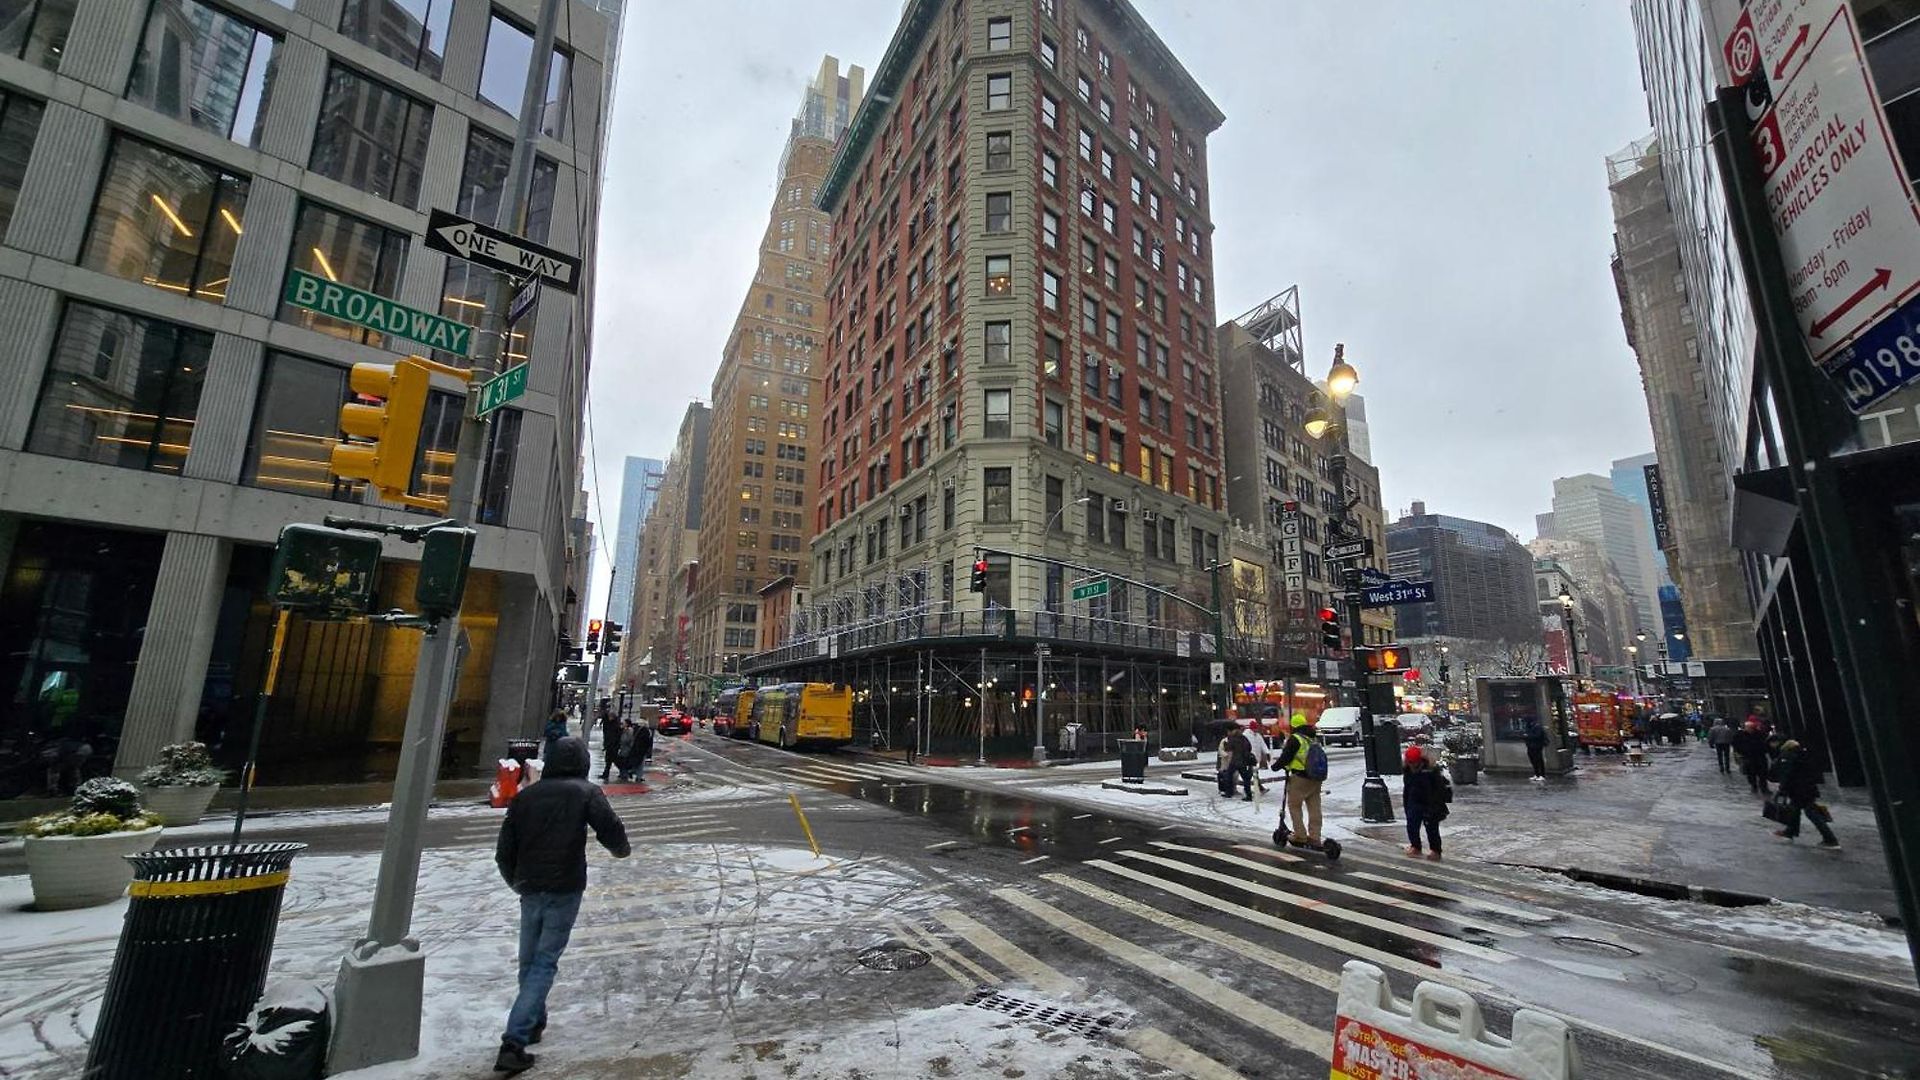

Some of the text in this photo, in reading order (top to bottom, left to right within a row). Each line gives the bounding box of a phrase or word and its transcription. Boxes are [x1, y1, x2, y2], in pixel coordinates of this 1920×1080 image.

[1784, 81, 1819, 135] metered
[1788, 105, 1820, 153] parking
[1758, 126, 1777, 174] 3
[1768, 113, 1846, 214] COMMERCIAL
[1774, 118, 1867, 236] VEHICLES ONLY
[453, 229, 562, 277] ONE WAY
[1790, 248, 1827, 290] Monday
[1832, 205, 1872, 249] Friday
[1823, 259, 1850, 288] 6pm
[295, 276, 467, 351] BROADWAY
[482, 370, 522, 411] W 31 ST
[1283, 523, 1301, 607] GIFTS
[1368, 587, 1427, 603] West 31st St
